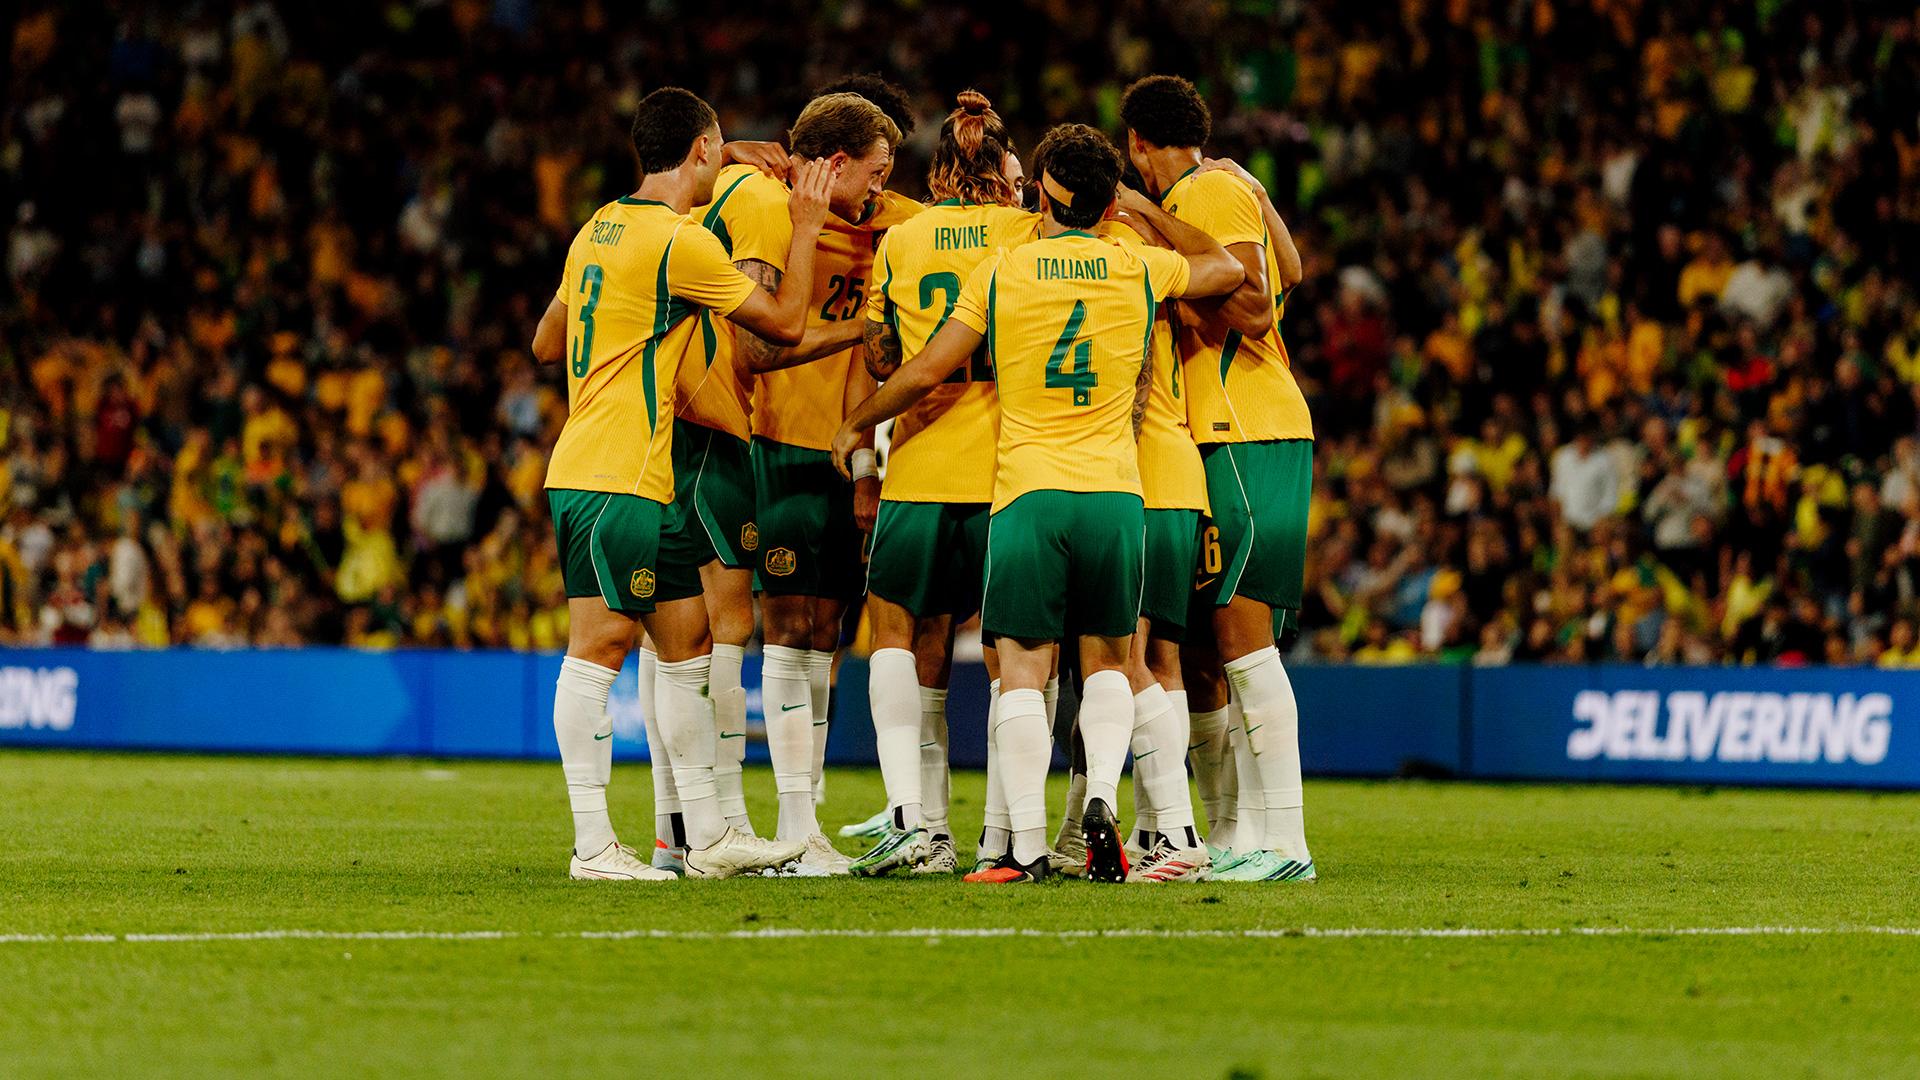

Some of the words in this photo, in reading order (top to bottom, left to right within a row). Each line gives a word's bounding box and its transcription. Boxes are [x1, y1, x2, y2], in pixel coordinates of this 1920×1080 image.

[590, 220, 626, 246] RCATI
[934, 225, 988, 250] IRVINE
[1037, 257, 1108, 280] ITALIANO
[572, 264, 605, 378] 3
[820, 273, 866, 321] 25
[1045, 299, 1098, 406] 4
[1196, 525, 1222, 574] 6
[1567, 690, 1892, 764] DELIVERING
